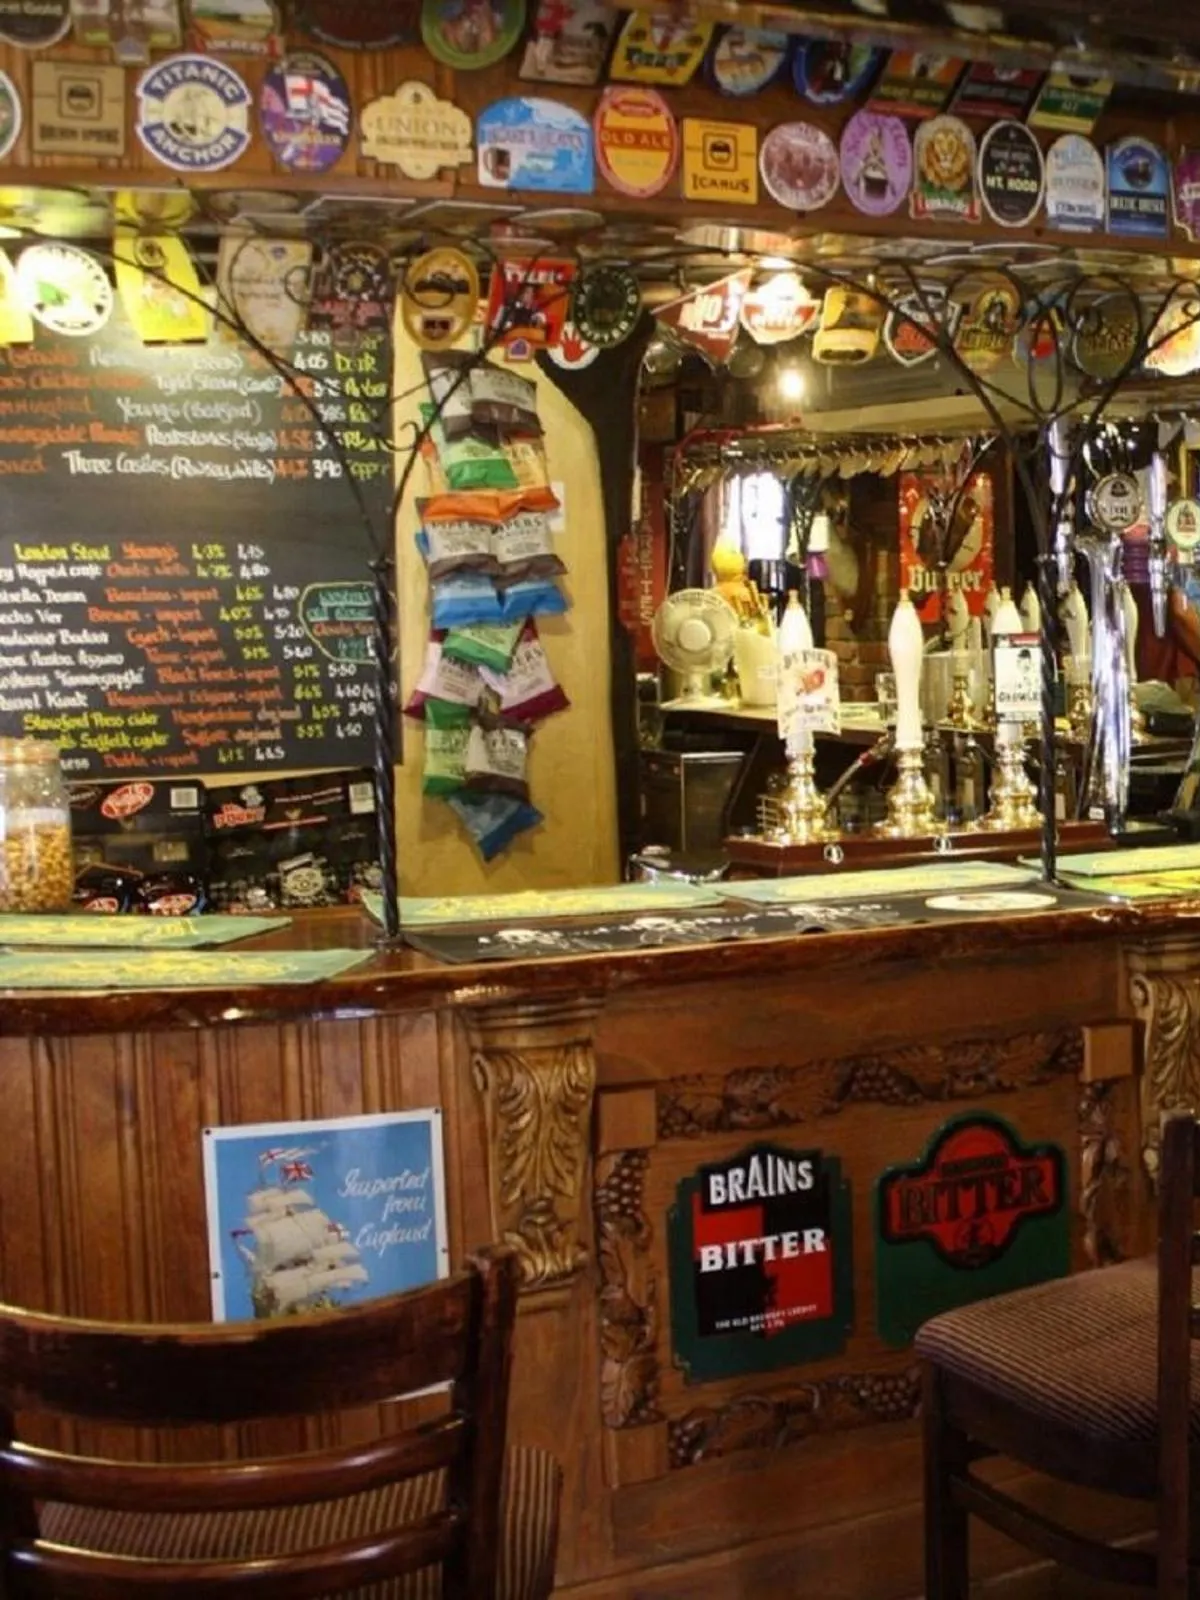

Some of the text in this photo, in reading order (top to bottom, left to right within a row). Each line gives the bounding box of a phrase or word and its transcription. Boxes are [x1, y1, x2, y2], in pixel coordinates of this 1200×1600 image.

[151, 59, 241, 98] TITANIC
[150, 127, 239, 167] ANCHOR
[600, 131, 636, 143] OLD
[639, 133, 672, 148] ALE
[688, 173, 750, 193] ICARUS
[62, 450, 112, 476] Three
[14, 543, 69, 561] London
[70, 542, 111, 561] Stout
[337, 1166, 430, 1198] Imported
[709, 1153, 815, 1206] BRAINS
[902, 1165, 1051, 1228] BITTER
[381, 1195, 426, 1222] from
[355, 1219, 433, 1259] England
[698, 1227, 830, 1273] BITTER
